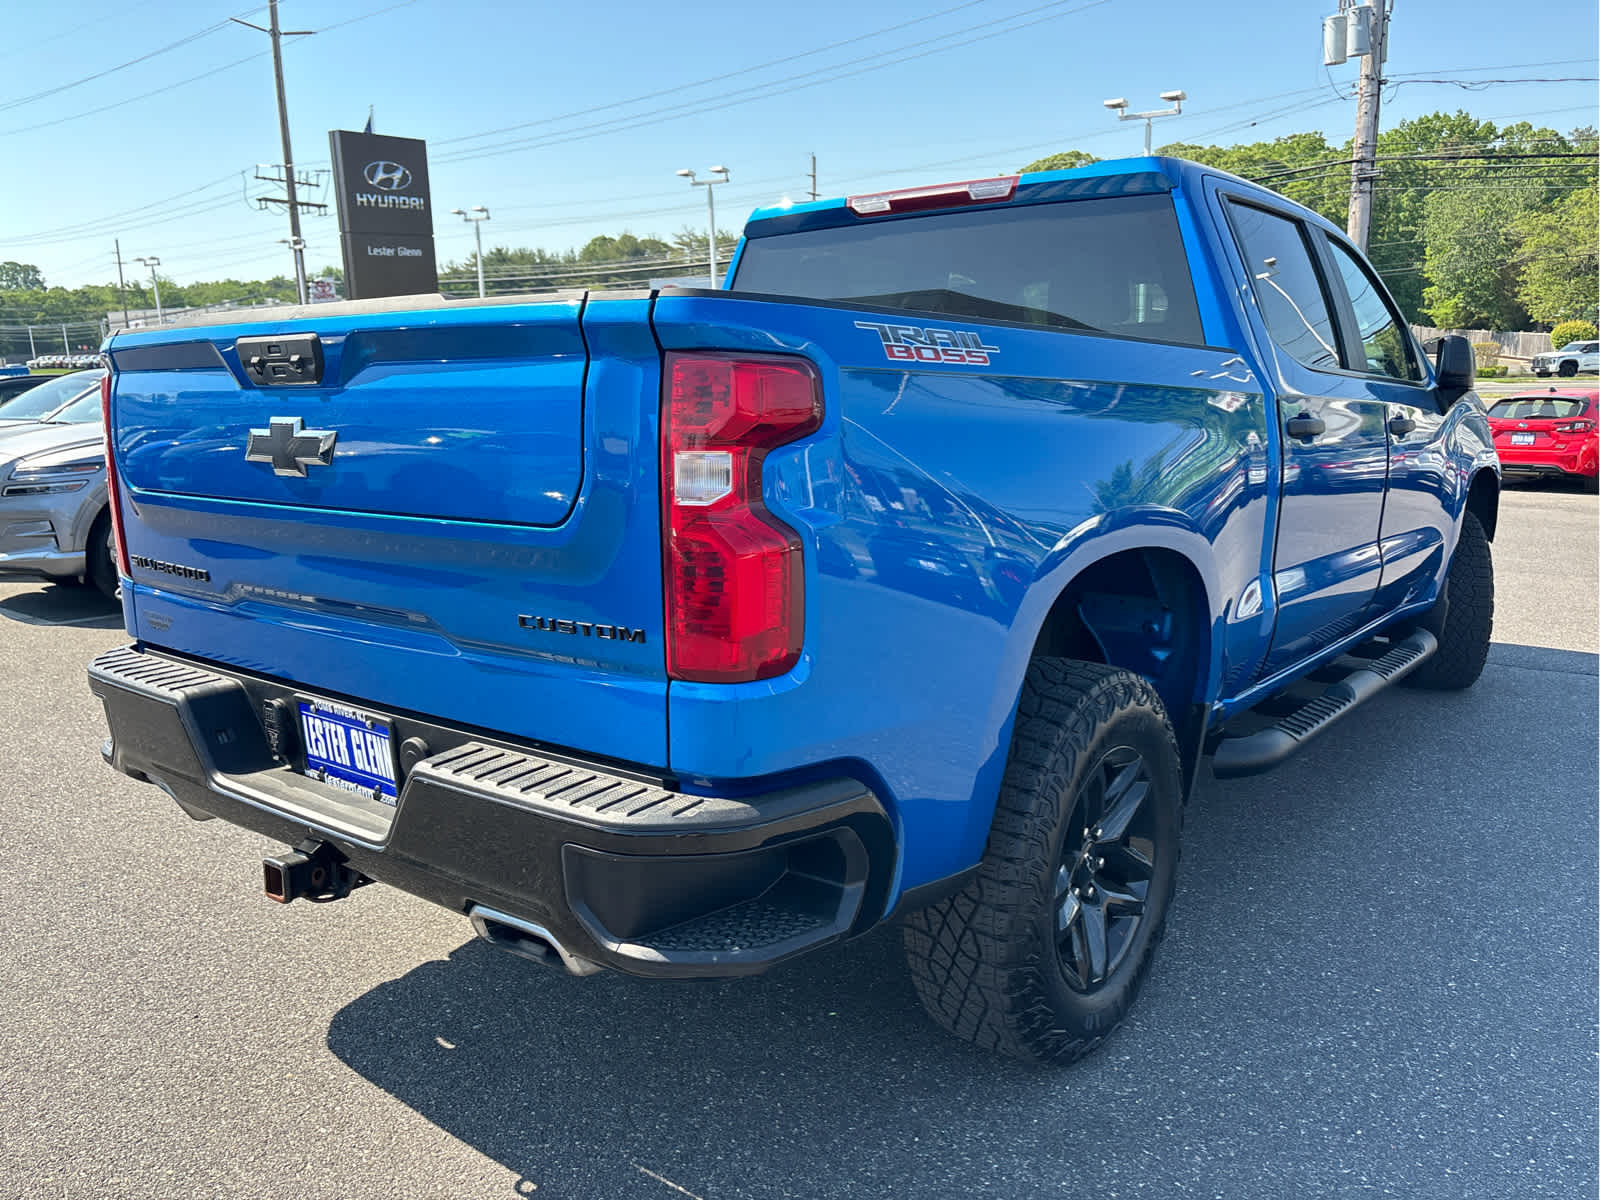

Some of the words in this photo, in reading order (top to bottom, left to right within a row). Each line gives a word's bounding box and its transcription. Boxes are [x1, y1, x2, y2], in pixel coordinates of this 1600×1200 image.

[356, 193, 424, 210] HYUNDAI
[367, 245, 395, 257] Lester
[397, 246, 422, 257] Glenn
[854, 320, 1000, 353] TRAIL
[884, 343, 990, 366] BOSS
[131, 554, 211, 582] SILVERADO
[518, 614, 646, 643] CUSTOM
[315, 701, 333, 713] TOMS
[302, 714, 351, 767] LESTER
[350, 728, 396, 781] GLENN
